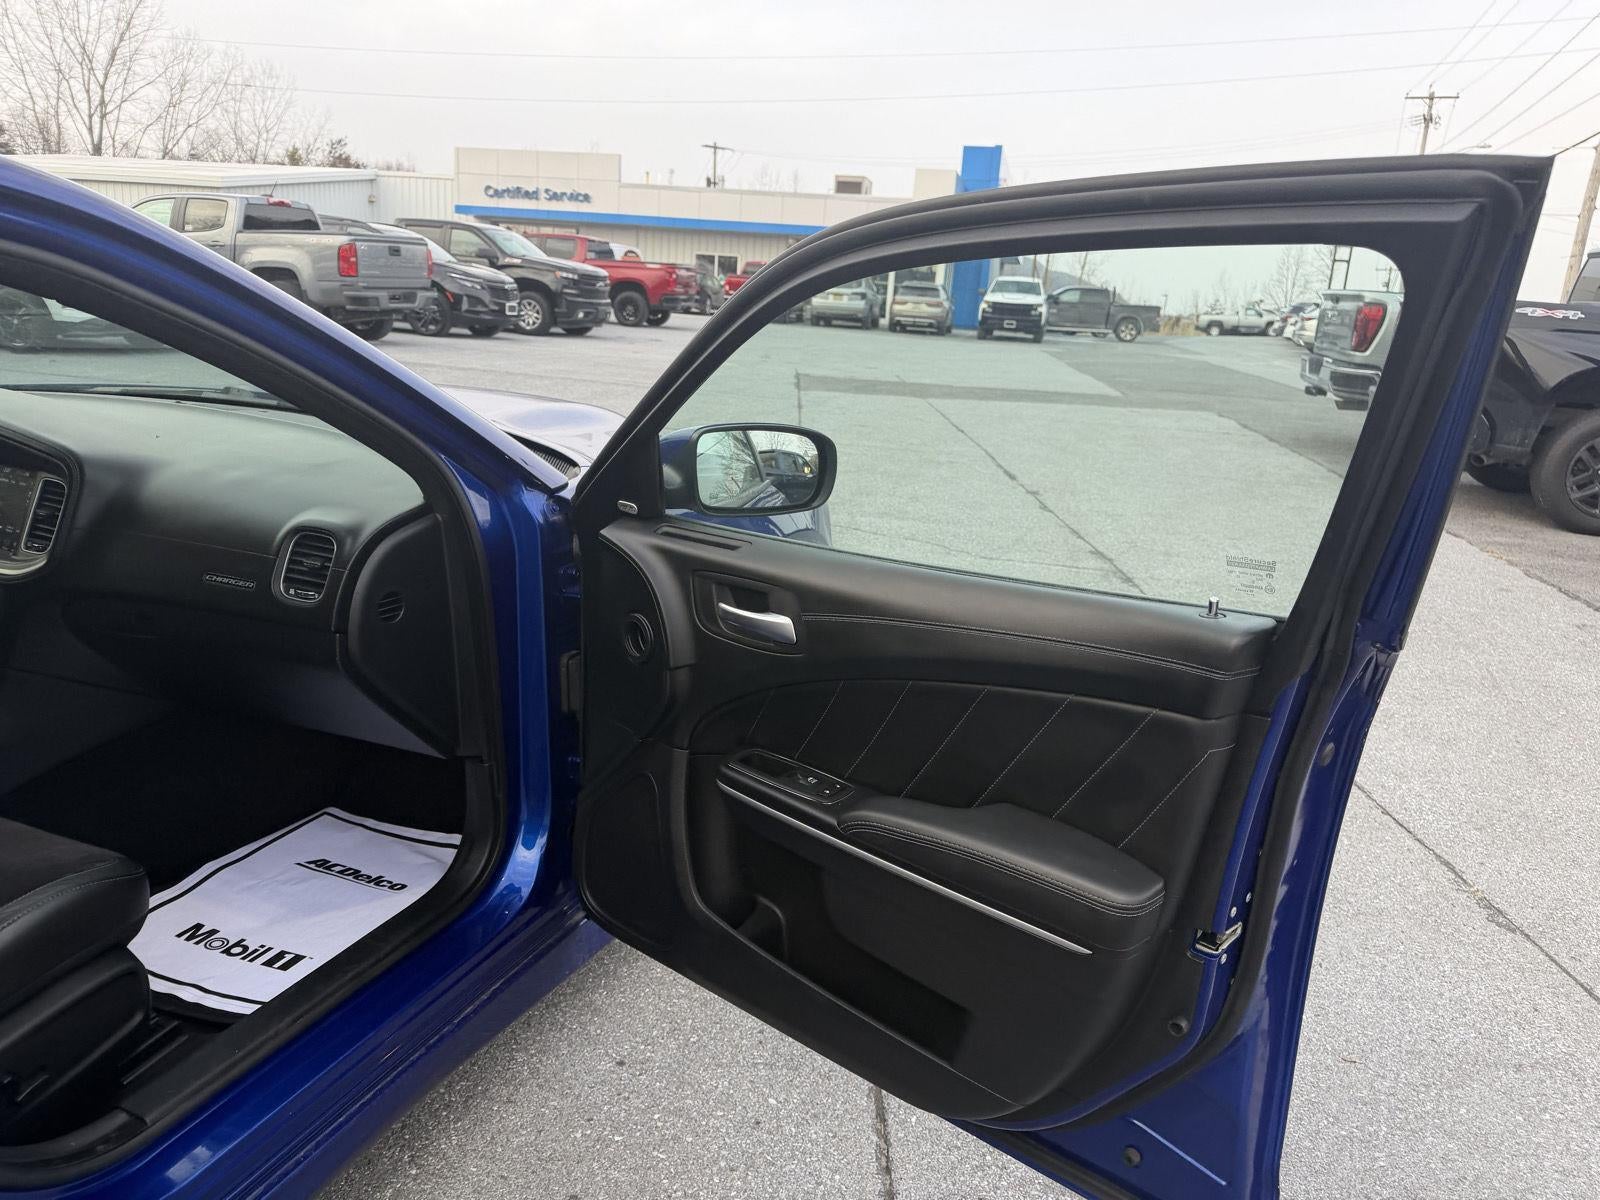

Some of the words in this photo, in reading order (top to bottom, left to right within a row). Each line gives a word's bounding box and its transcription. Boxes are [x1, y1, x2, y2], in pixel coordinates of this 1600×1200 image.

[484, 184, 540, 200] Certified
[544, 187, 592, 203] Service
[205, 573, 255, 588] CHARGER
[303, 858, 408, 891] ACDelco
[174, 922, 274, 963] Mobil
